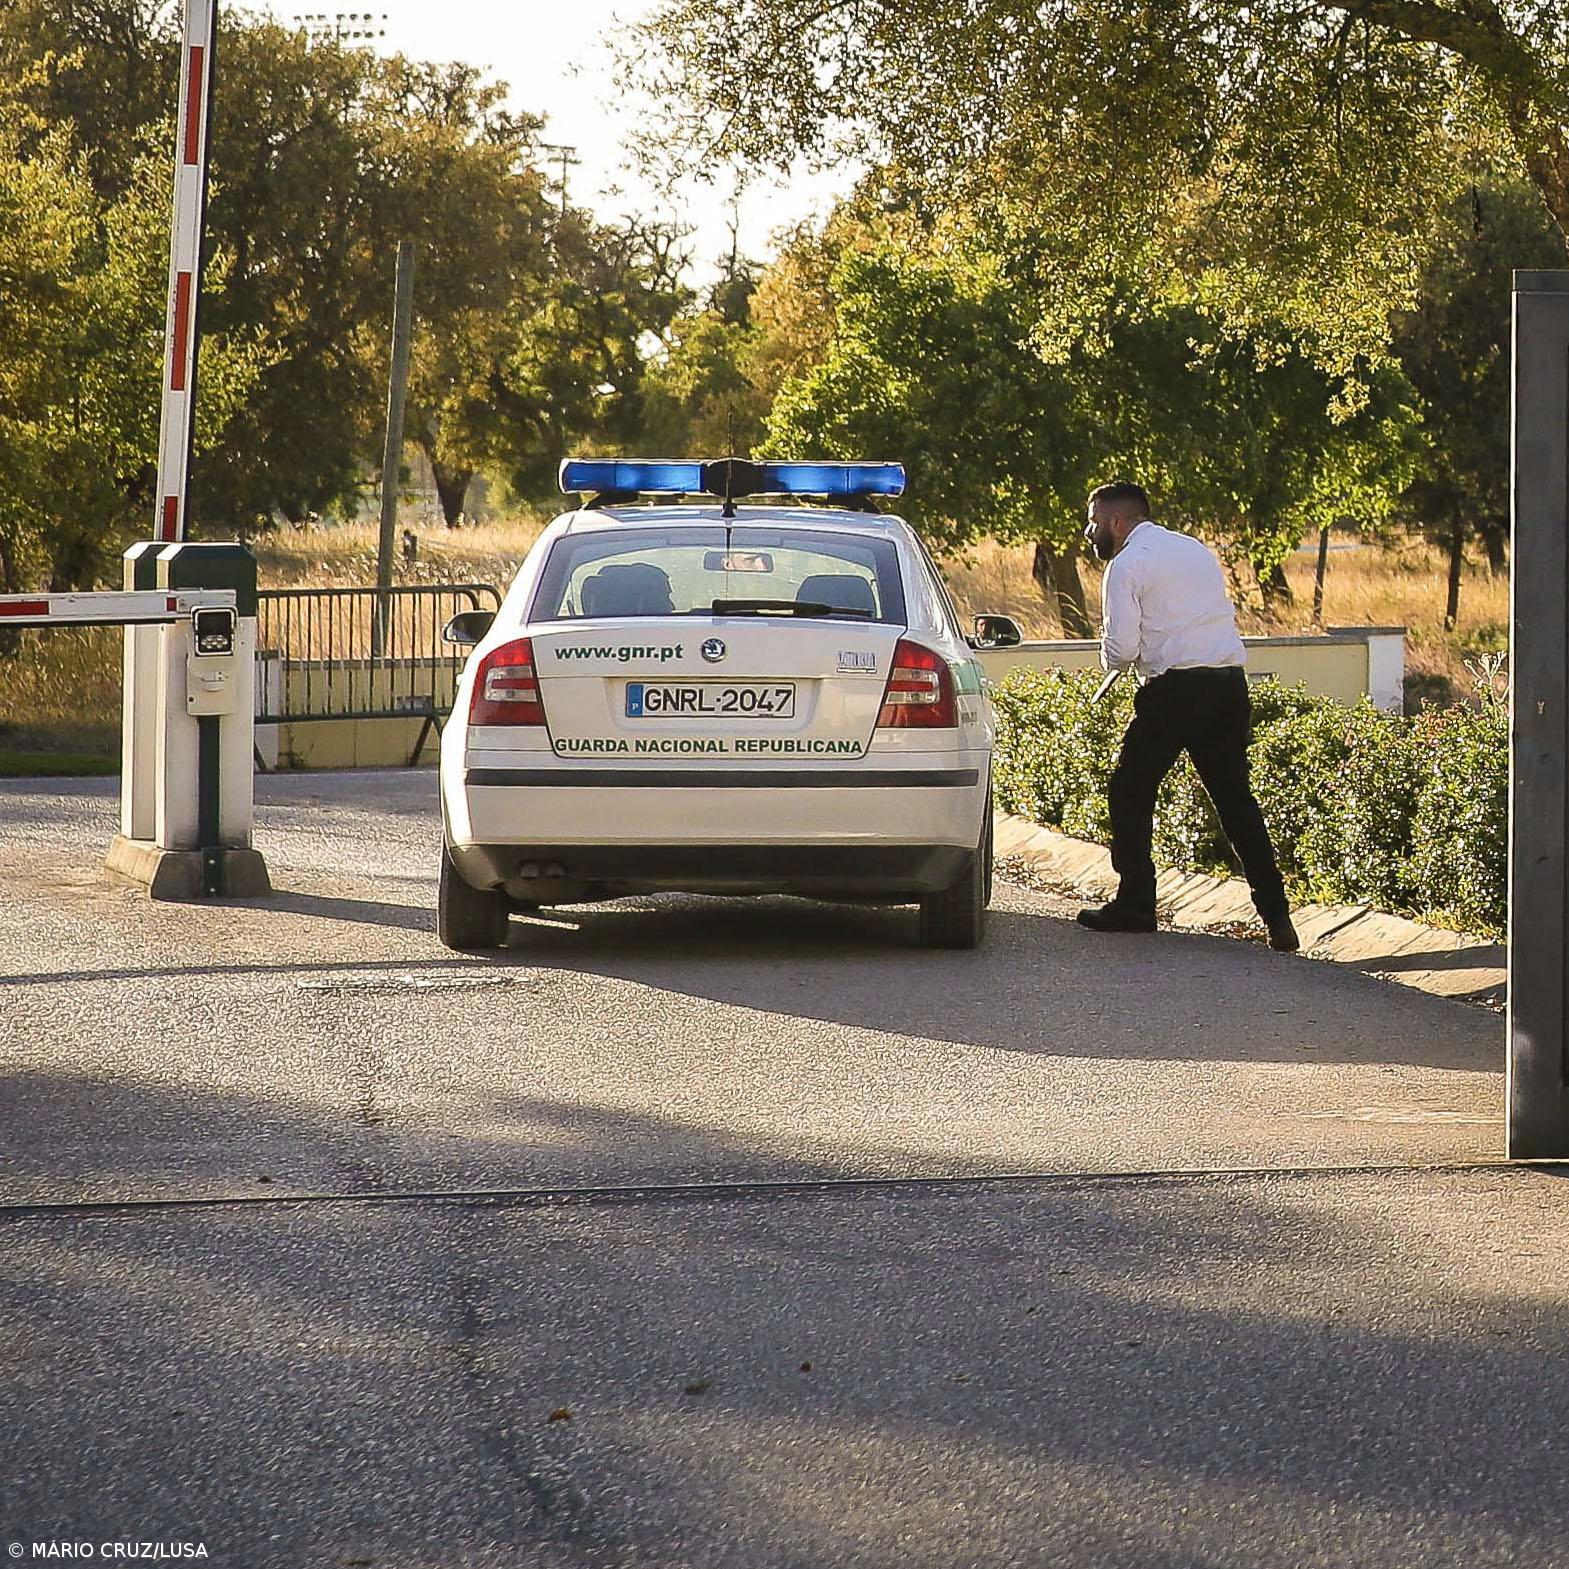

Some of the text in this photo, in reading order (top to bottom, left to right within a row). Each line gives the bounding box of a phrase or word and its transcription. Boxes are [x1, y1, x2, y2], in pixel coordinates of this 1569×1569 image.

[554, 643, 684, 663] www.gnr.pt
[554, 738, 863, 754] GUARDA NACIONAL REPUBLICANA
